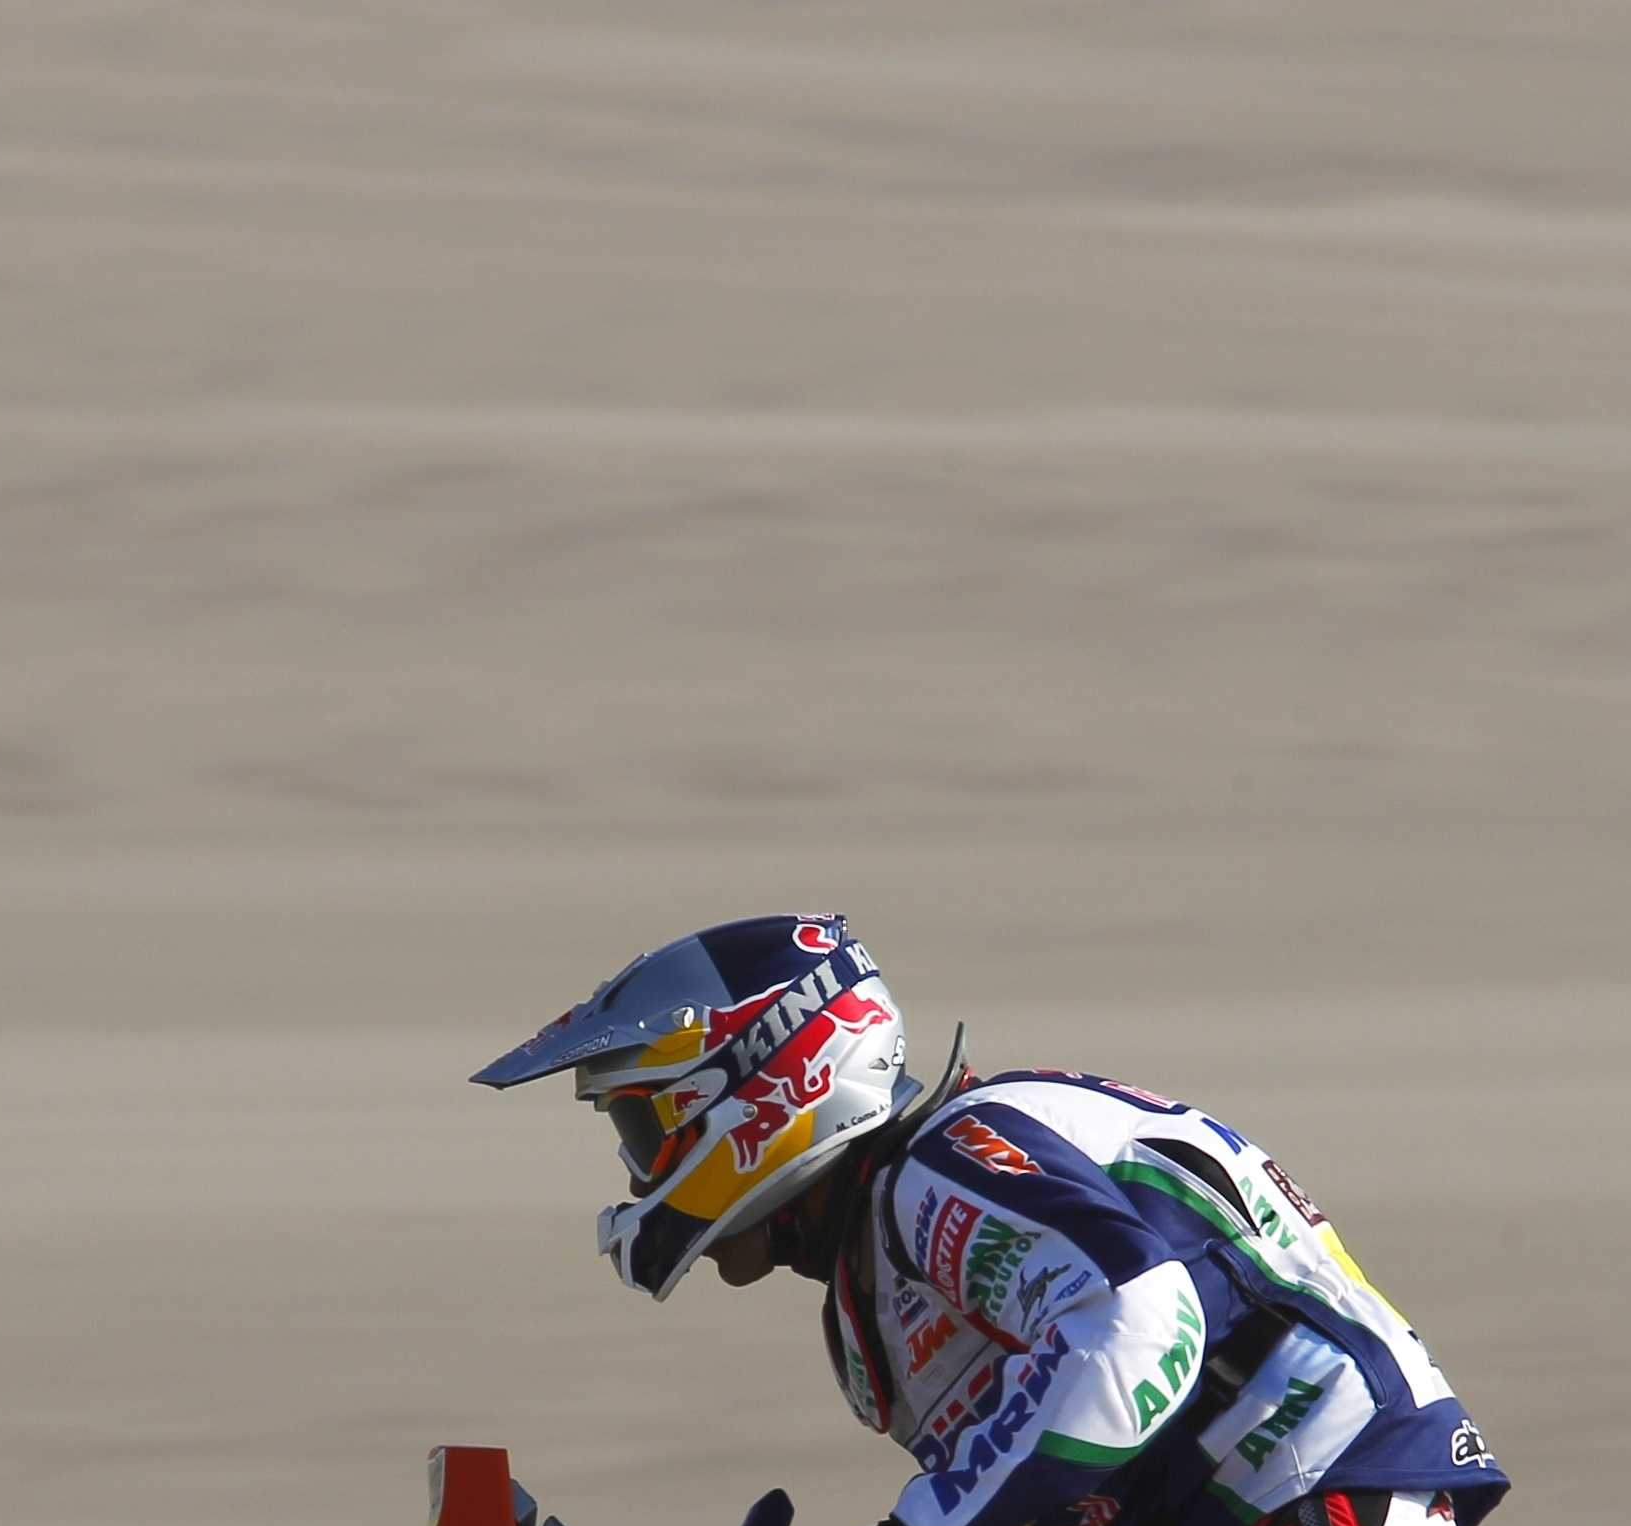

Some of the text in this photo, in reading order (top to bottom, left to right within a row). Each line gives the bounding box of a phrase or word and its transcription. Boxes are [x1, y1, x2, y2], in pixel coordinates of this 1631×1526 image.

[731, 959, 843, 1078] KINI
[851, 1109, 877, 1126] Coma
[935, 1202, 968, 1303] LOCTITE
[929, 1322, 1070, 1517] MRW
